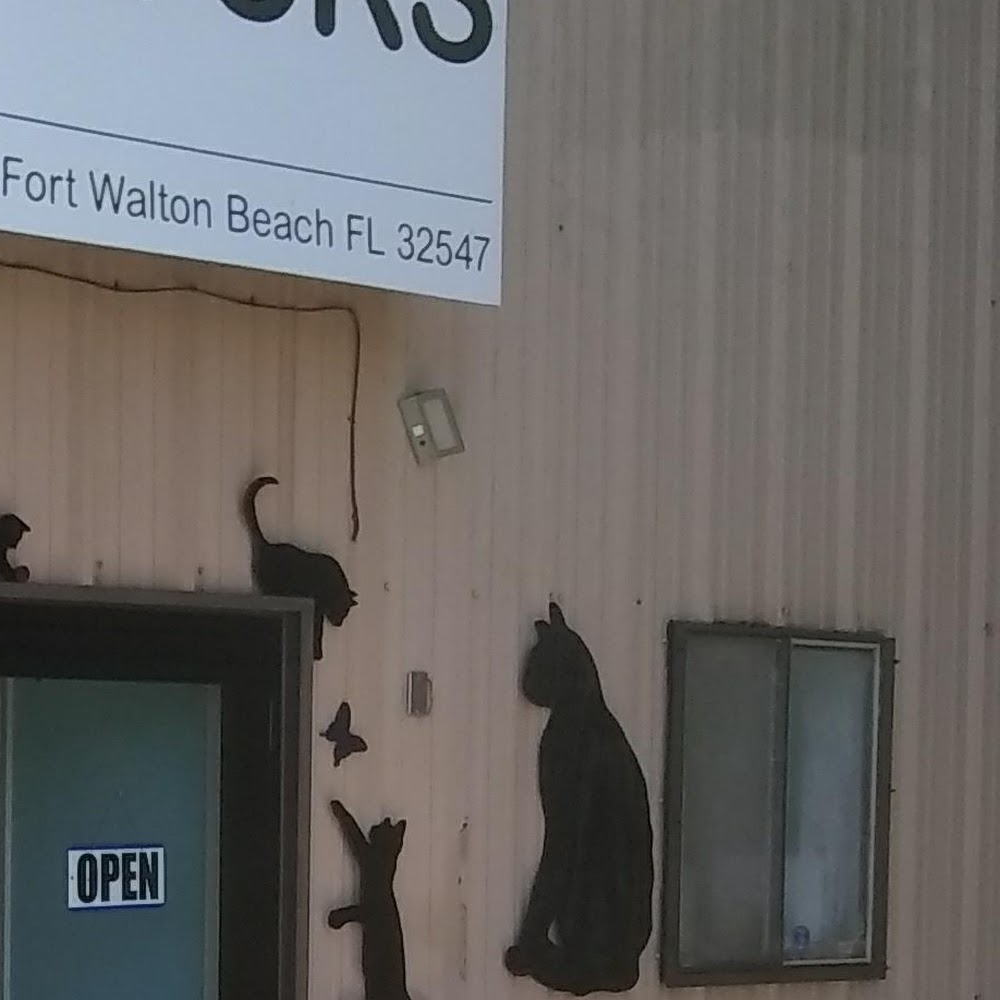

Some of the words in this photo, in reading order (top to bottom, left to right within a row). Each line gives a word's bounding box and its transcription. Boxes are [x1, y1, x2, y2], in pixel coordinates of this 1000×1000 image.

[2, 156, 78, 208] Fort
[89, 170, 212, 229] Walton
[227, 194, 334, 248] Beach
[347, 214, 386, 257] FL
[397, 223, 491, 272] 32547
[77, 851, 159, 903] OPEN
